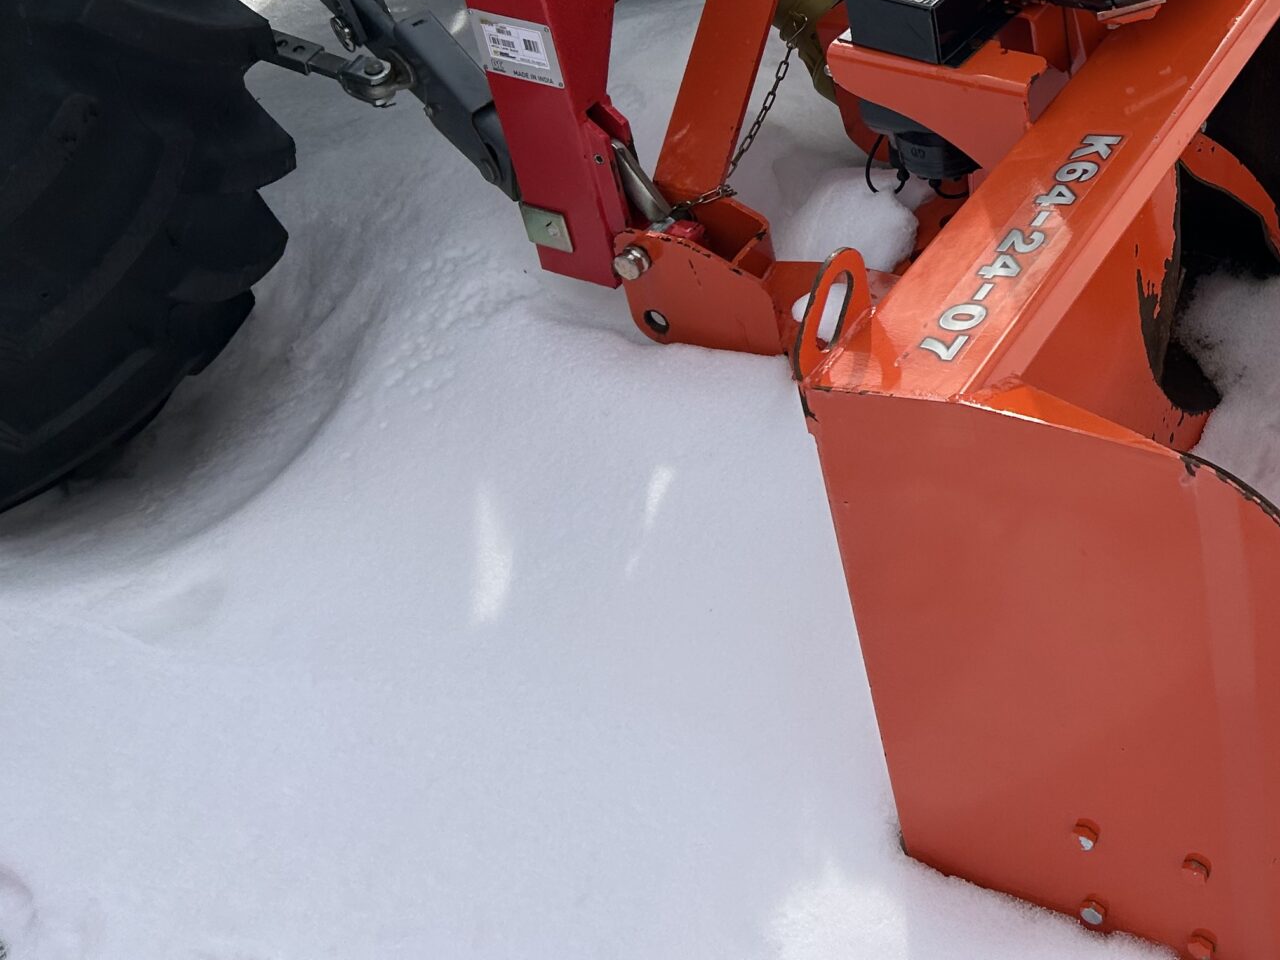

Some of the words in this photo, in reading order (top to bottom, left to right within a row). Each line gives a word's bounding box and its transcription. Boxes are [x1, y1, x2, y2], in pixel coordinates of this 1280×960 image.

[513, 69, 529, 79] MADE
[530, 73, 537, 81] IN
[538, 75, 554, 84] INDIA
[919, 134, 1124, 361] K64-24-07
